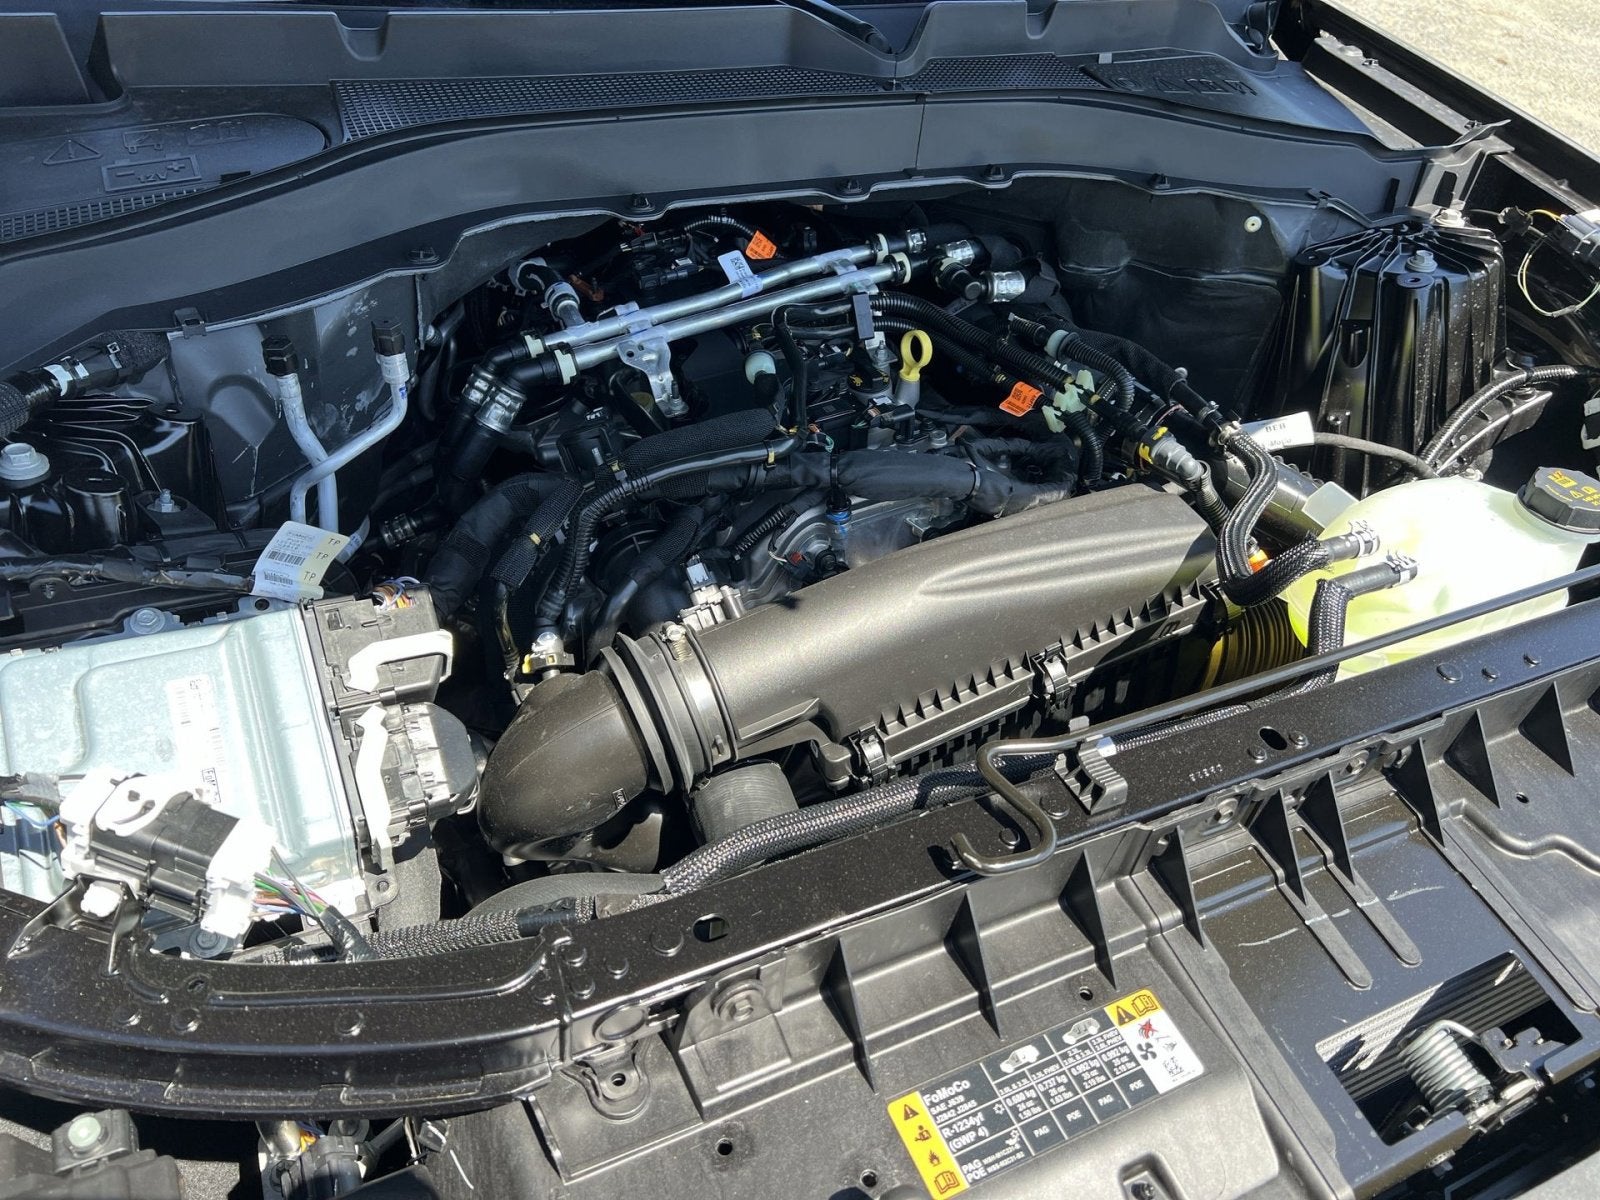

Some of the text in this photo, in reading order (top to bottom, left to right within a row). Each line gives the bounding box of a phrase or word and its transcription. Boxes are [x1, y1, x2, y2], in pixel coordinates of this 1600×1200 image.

[328, 538, 341, 546] TP
[316, 552, 329, 560] TP
[303, 571, 316, 581] TP
[1106, 1034, 1122, 1046] PHEV
[1101, 1045, 1130, 1062] 0.992 kg
[1120, 1055, 1129, 1063] oz
[1043, 1063, 1060, 1074] FHEV
[1070, 1058, 1101, 1076] 0.992 kg
[1125, 1061, 1136, 1069] lbs
[1037, 1074, 1068, 1092] 0.737 kg
[1094, 1074, 1106, 1083] lbs
[1129, 1079, 1144, 1091] POE
[922, 1079, 971, 1106] FoMoCo
[1023, 1088, 1037, 1098] kg
[1061, 1091, 1073, 1099] lbs
[930, 1094, 965, 1115] SAE J639
[1025, 1099, 1034, 1107] oz
[1097, 1094, 1113, 1106] PAG
[956, 1099, 977, 1114] J2845
[1030, 1106, 1042, 1114] lbs
[1066, 1109, 1082, 1122] POE
[941, 1111, 985, 1138] R-1234yf
[1033, 1125, 1050, 1137] PAG
[948, 1125, 989, 1152] (GWP 4)
[961, 1159, 982, 1174] PAG
[965, 1166, 987, 1183] POE
